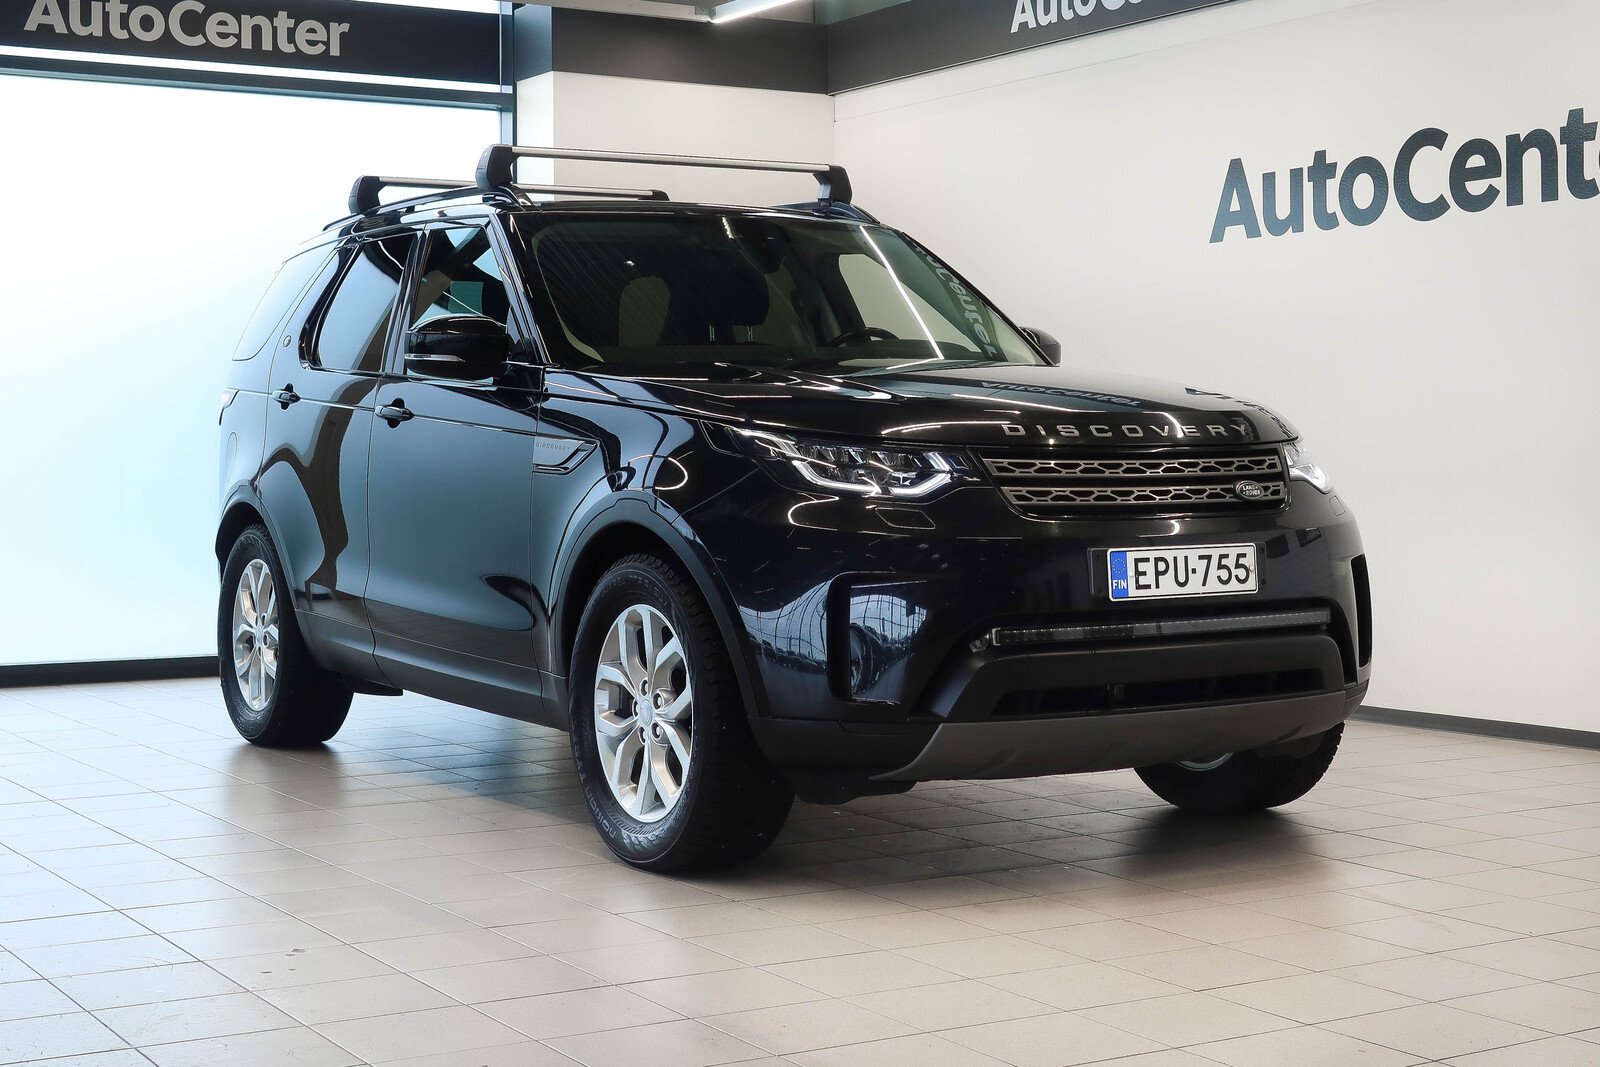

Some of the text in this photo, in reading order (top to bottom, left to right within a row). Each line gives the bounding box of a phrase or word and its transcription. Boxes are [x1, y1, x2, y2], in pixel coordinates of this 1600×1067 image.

[24, 0, 350, 56] AutoCenter
[1209, 108, 1600, 243] AutoCent
[1001, 424, 1247, 437] DISCOVERY
[536, 442, 571, 451] DISCOVERY
[1134, 552, 1250, 590] EPU-755
[1112, 579, 1127, 590] FIN
